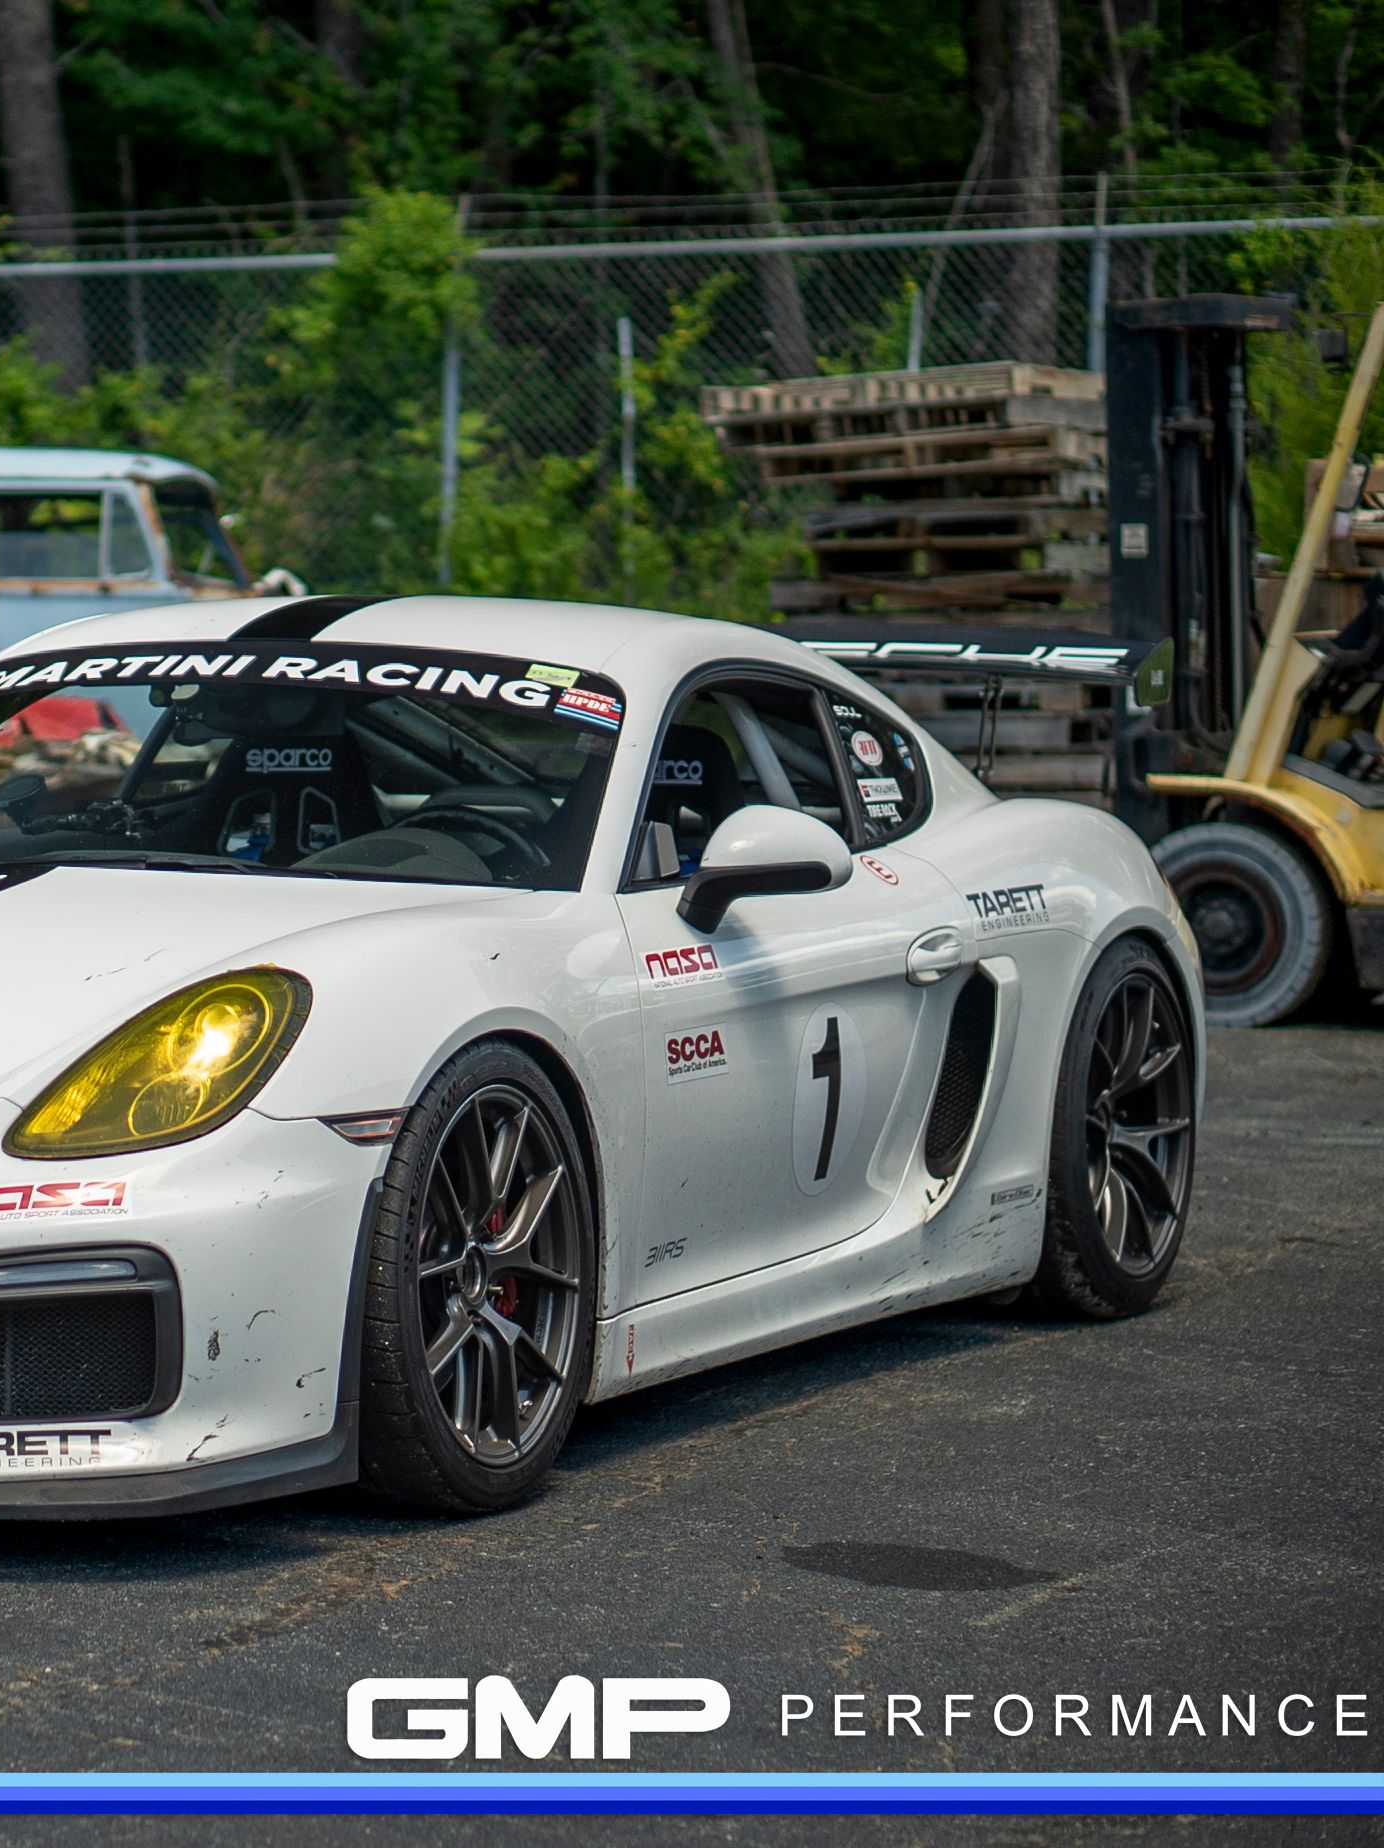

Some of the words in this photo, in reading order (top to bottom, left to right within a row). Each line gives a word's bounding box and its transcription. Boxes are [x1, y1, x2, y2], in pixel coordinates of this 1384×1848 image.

[261, 656, 552, 708] RACING
[245, 748, 332, 773] sparco
[965, 884, 1046, 918] TARETT
[980, 911, 1050, 932] ENGINEERING
[667, 1030, 725, 1065] SCCA
[811, 1016, 842, 1181] 1
[24, 1209, 60, 1219] SPORT
[62, 1208, 129, 1217] ASSOCIATION
